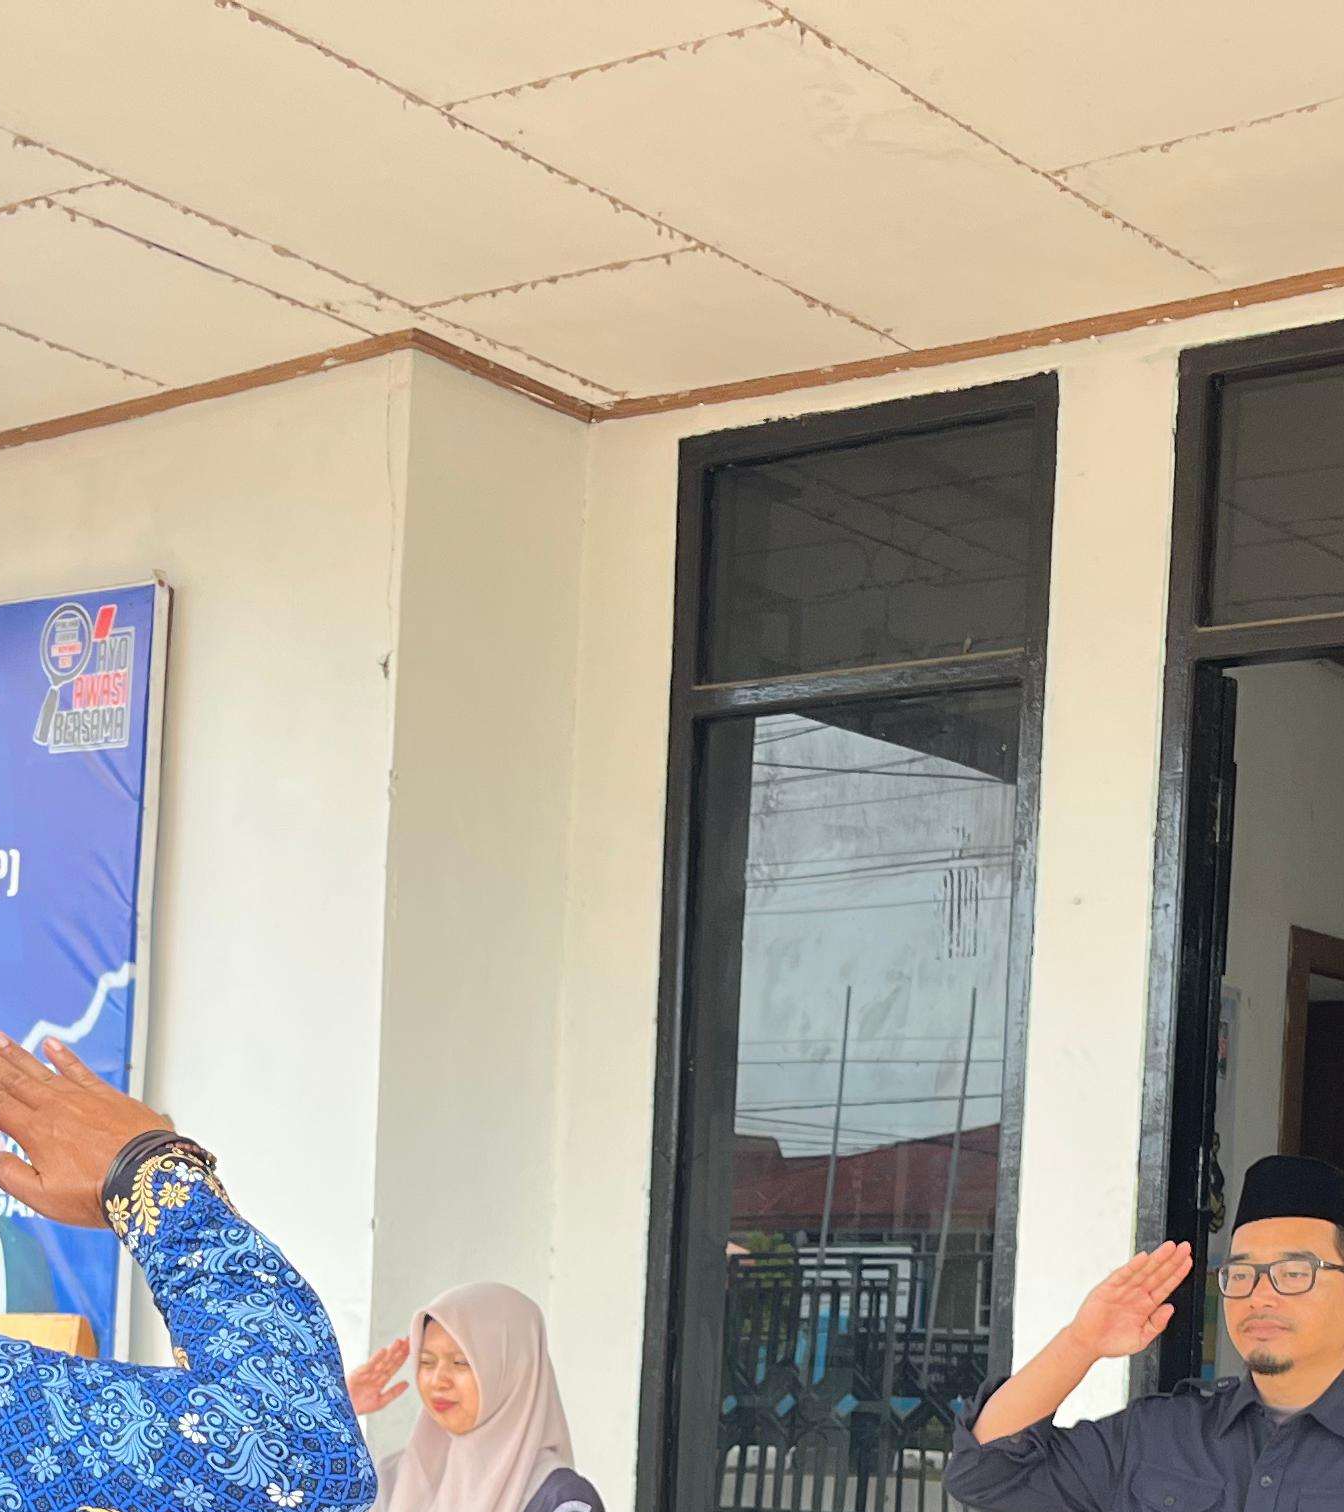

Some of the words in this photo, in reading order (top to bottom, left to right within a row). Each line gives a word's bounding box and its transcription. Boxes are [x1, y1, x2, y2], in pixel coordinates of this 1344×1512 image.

[98, 637, 128, 671] AYO
[73, 673, 128, 708] AWASI
[54, 706, 125, 745] BERSAMA
